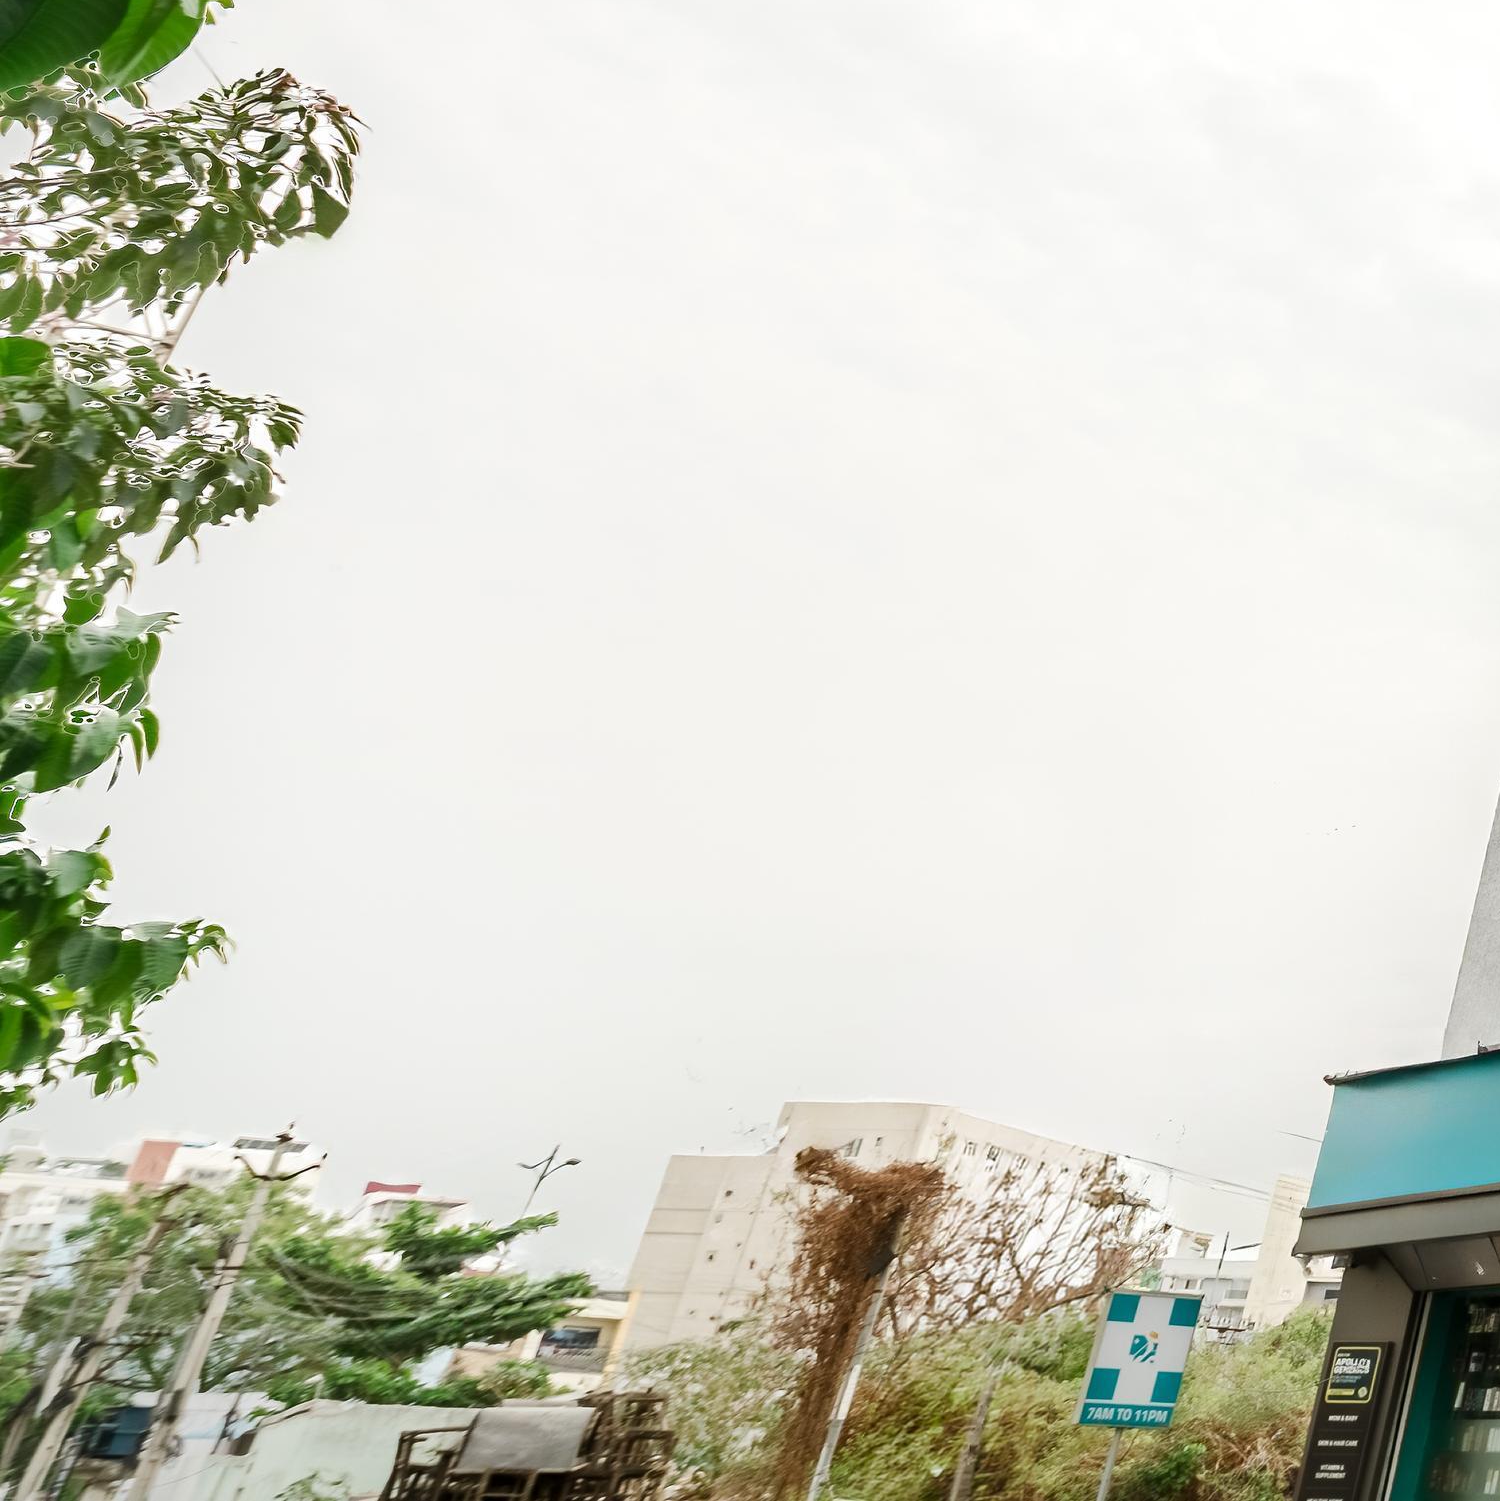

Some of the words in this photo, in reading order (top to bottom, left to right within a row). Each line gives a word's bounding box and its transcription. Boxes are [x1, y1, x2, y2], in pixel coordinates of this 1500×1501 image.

[1087, 1407, 1115, 1421] 7AM
[1117, 1408, 1132, 1421] TO
[1135, 1409, 1168, 1423] 11PM
